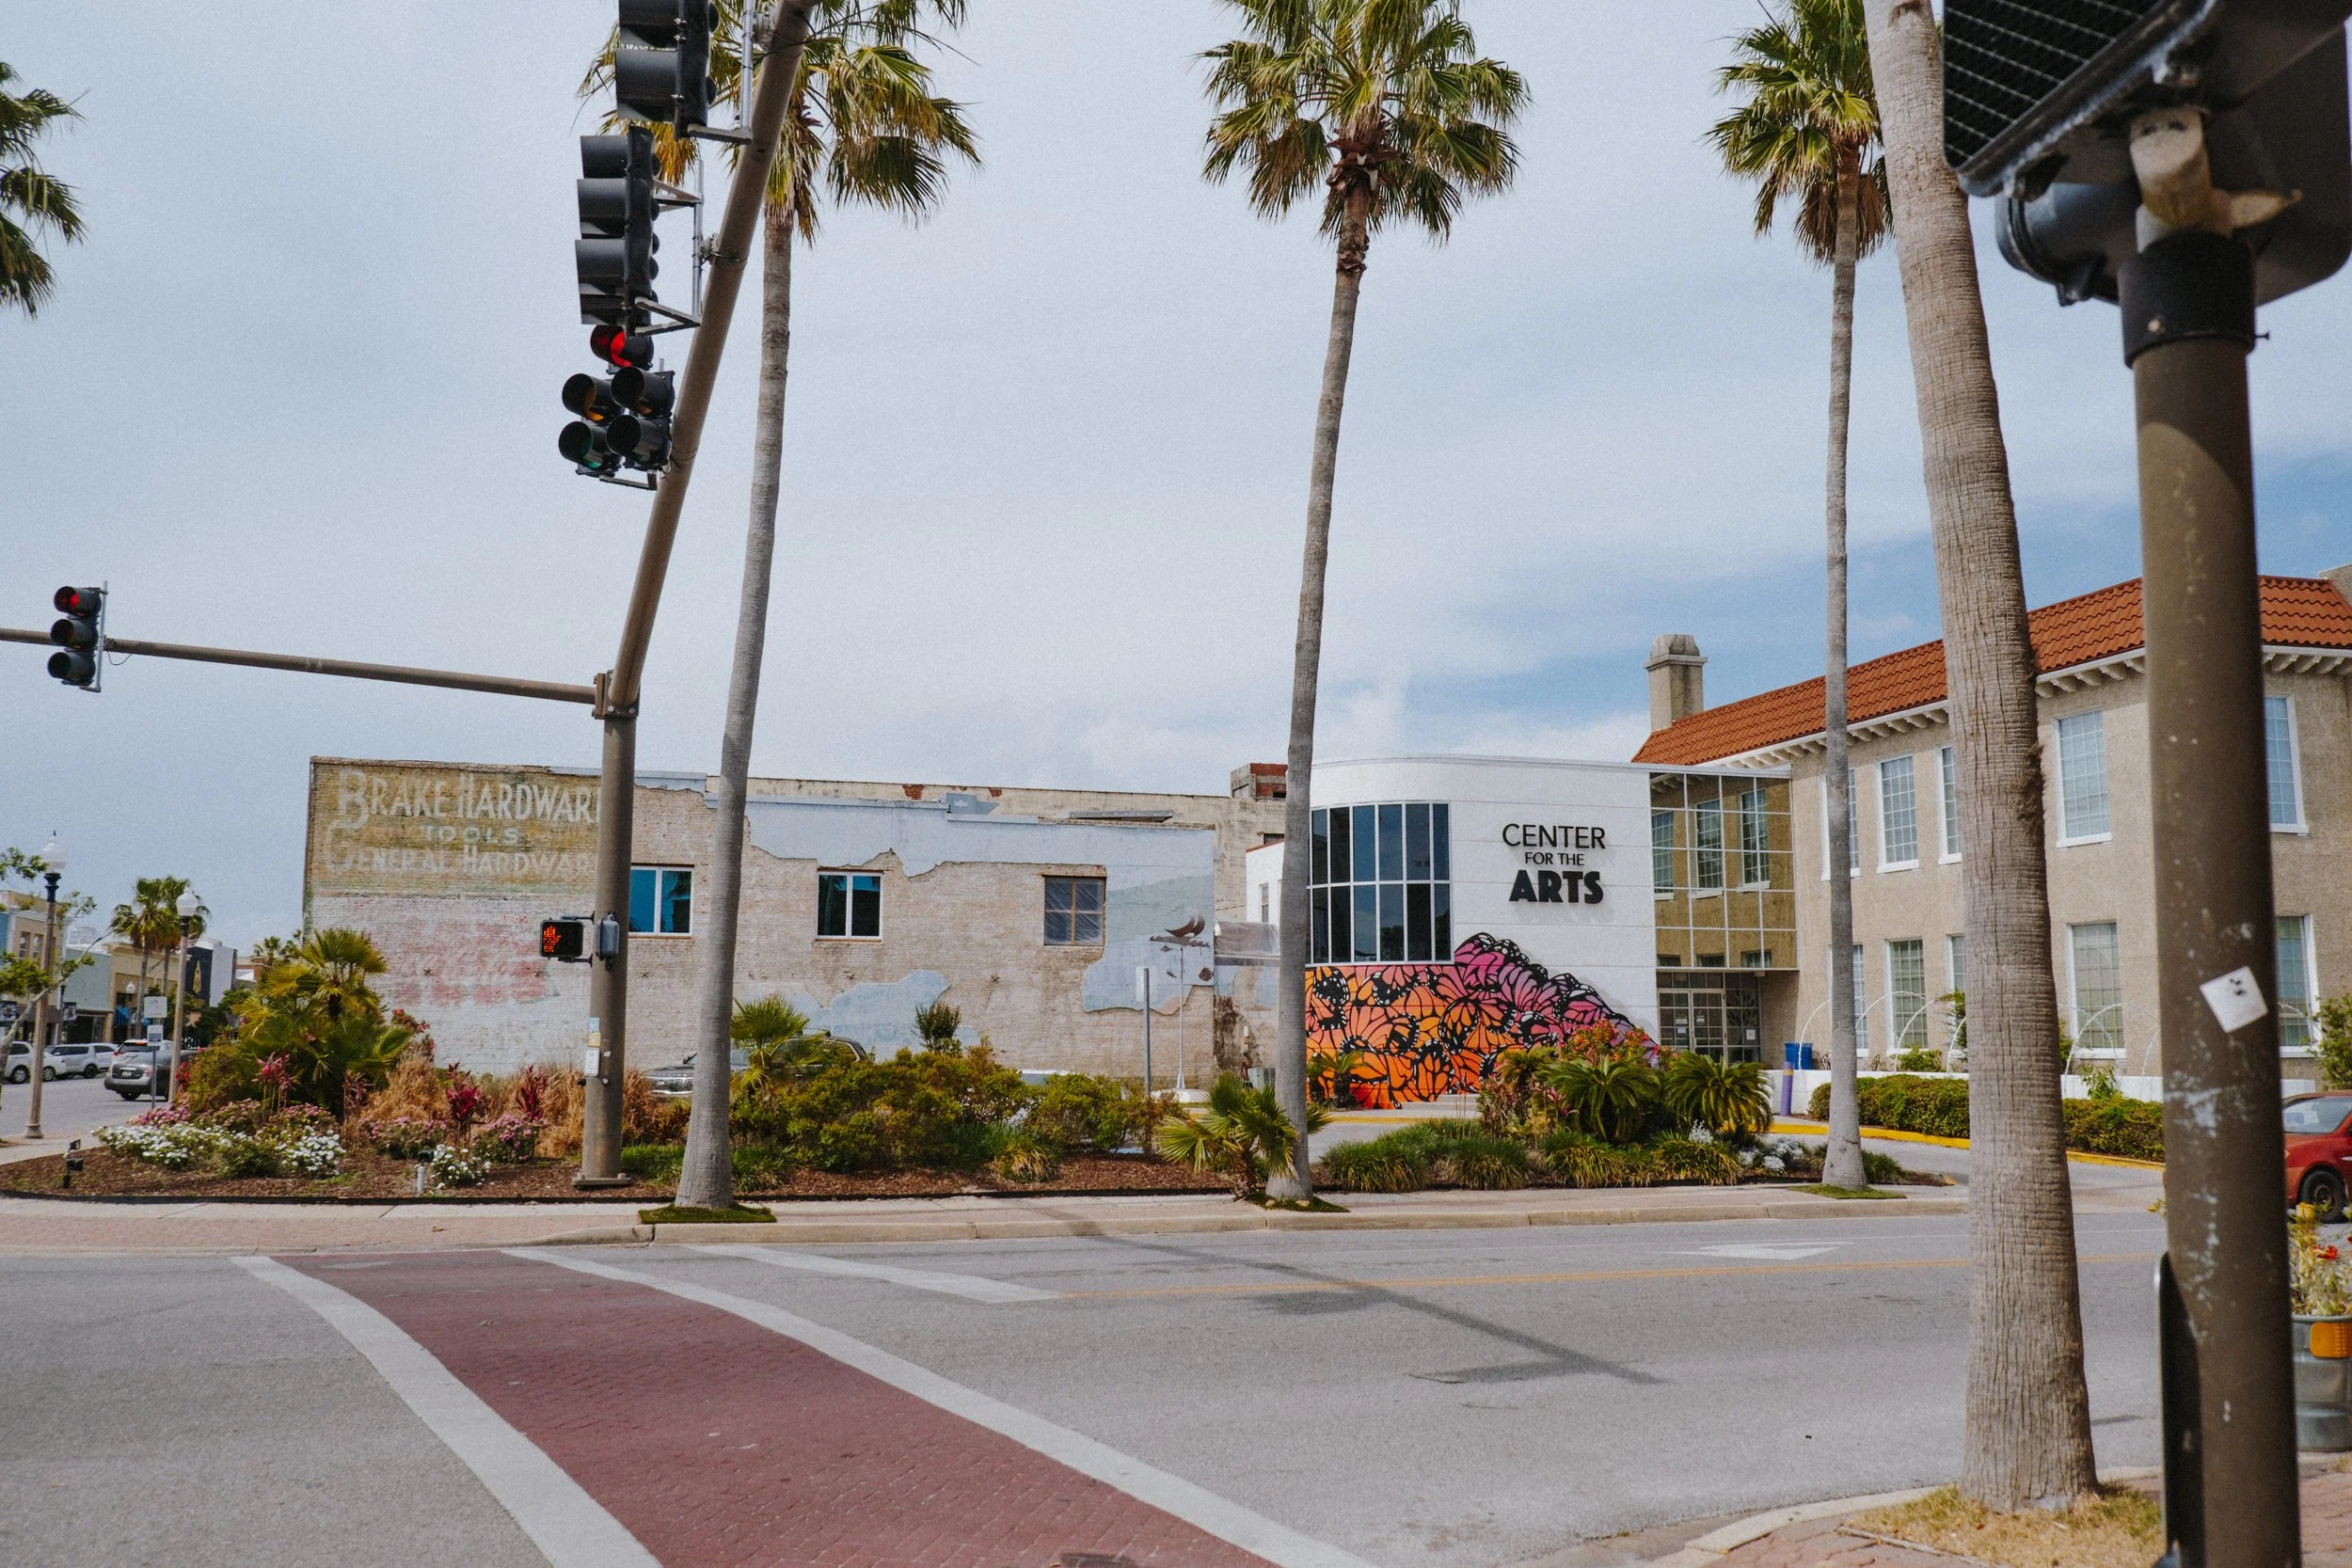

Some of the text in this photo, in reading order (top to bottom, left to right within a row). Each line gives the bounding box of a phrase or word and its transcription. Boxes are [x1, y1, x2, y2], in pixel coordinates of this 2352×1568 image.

[339, 768, 449, 828] BRAKE
[421, 824, 518, 846] TOOLS
[1502, 823, 1606, 849] CENTER
[463, 844, 596, 878] HARDWAR
[1524, 851, 1585, 866] FOR THE
[1508, 869, 1604, 905] ARTS
